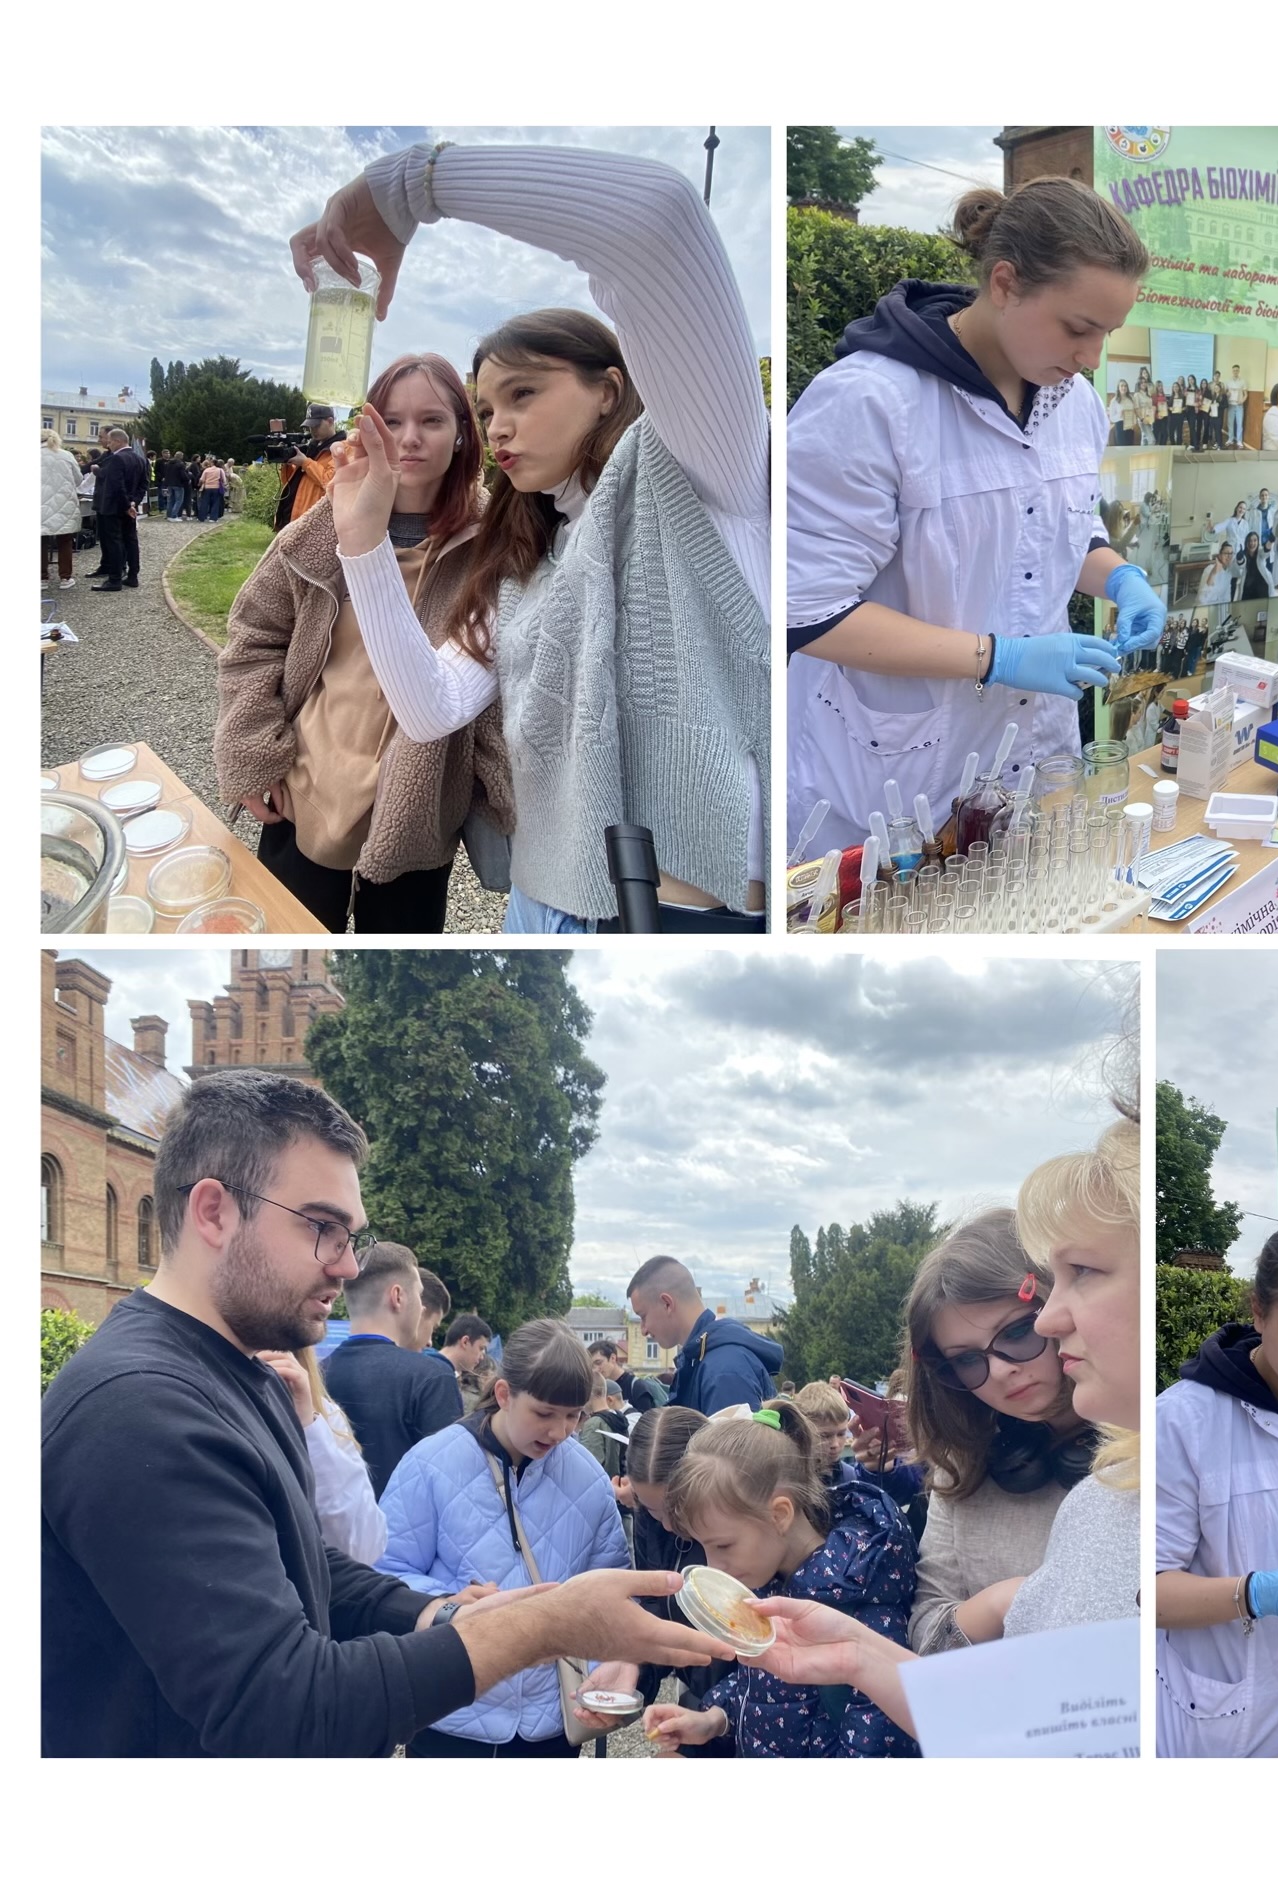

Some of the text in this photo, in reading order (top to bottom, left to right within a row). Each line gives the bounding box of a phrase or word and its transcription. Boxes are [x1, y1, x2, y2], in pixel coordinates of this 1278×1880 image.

[1109, 167, 1204, 215] КАФЕДРА
[1199, 264, 1220, 276] та
[1233, 302, 1253, 316] та
